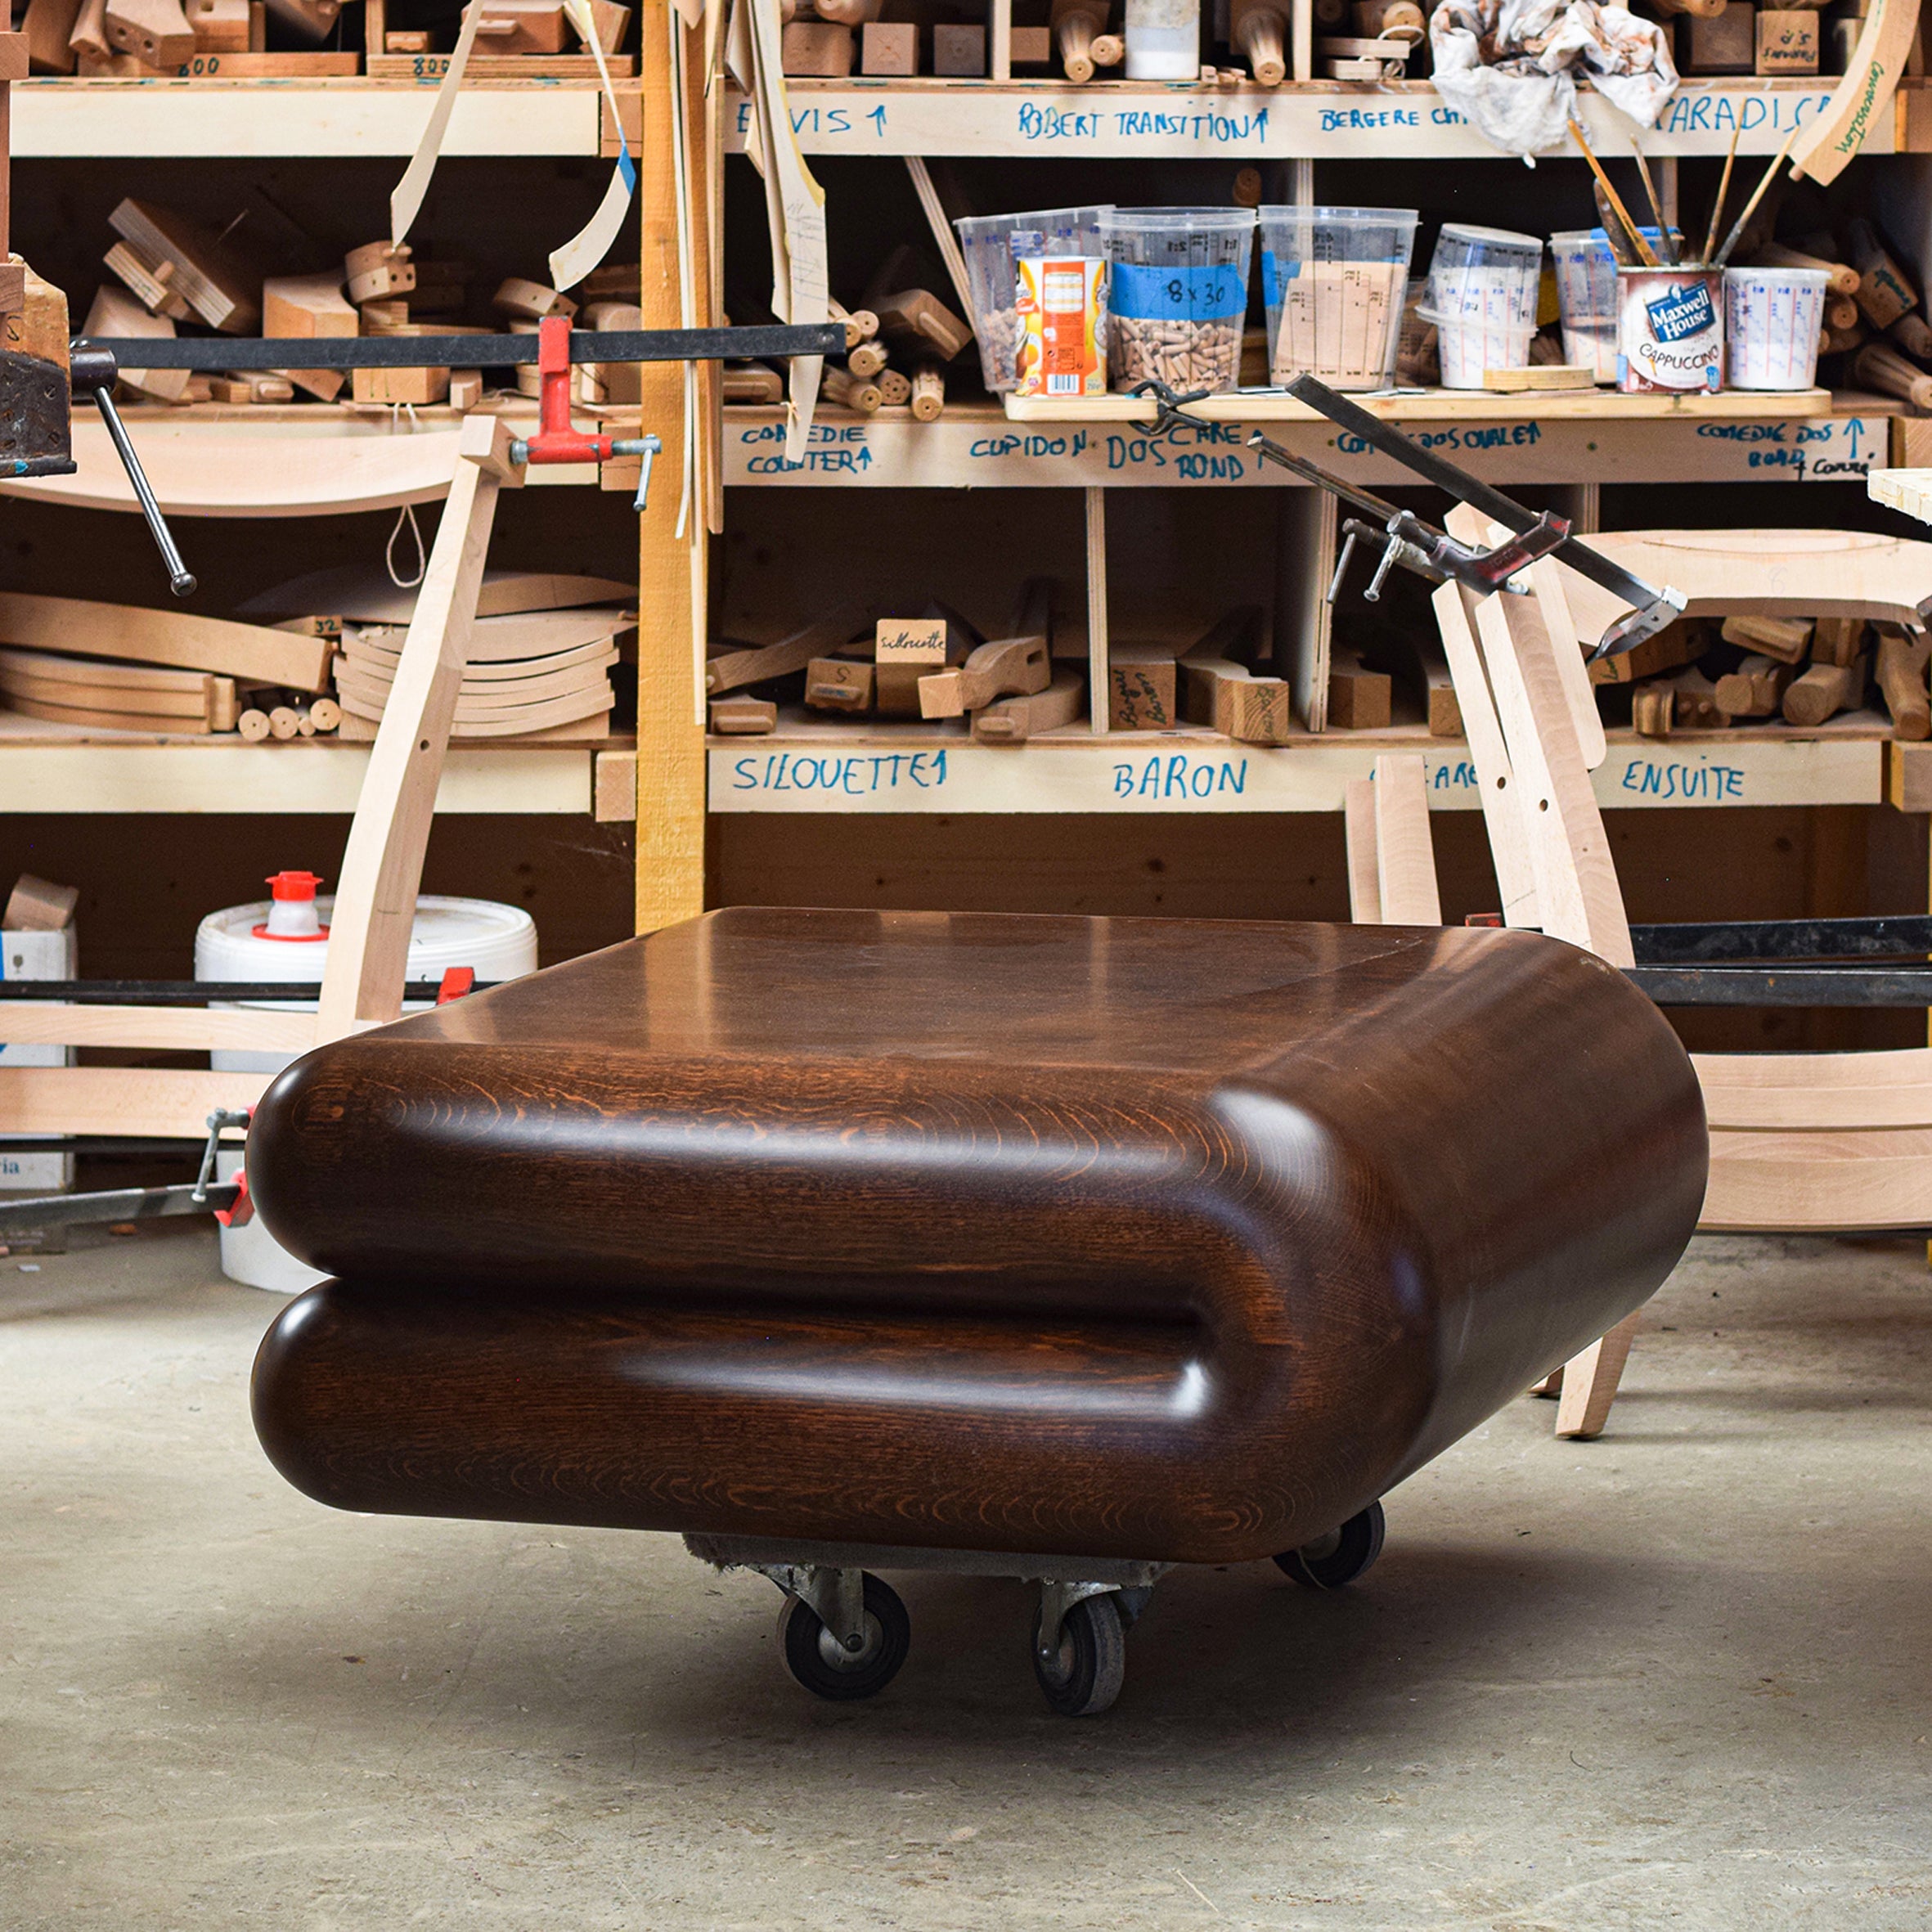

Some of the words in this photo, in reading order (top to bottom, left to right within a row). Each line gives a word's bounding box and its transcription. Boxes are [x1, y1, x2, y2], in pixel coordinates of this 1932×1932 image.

[736, 103, 851, 134] EVIS
[1318, 108, 1420, 132] BERGERE
[1166, 278, 1184, 303] 8
[1203, 282, 1226, 307] 30
[1651, 288, 1710, 329] Maxwell
[1663, 308, 1709, 341] House
[1639, 342, 1719, 371] CAPPUCCINO
[1697, 422, 1787, 443] COMEDIE
[1796, 423, 1834, 444] DOS
[1106, 436, 1167, 470] DOS
[1175, 453, 1244, 480] ROND
[316, 618, 339, 634] 32
[733, 753, 930, 795] SILOUETTE
[1112, 755, 1247, 799] BARON
[1622, 755, 1746, 801] ENSUITE
